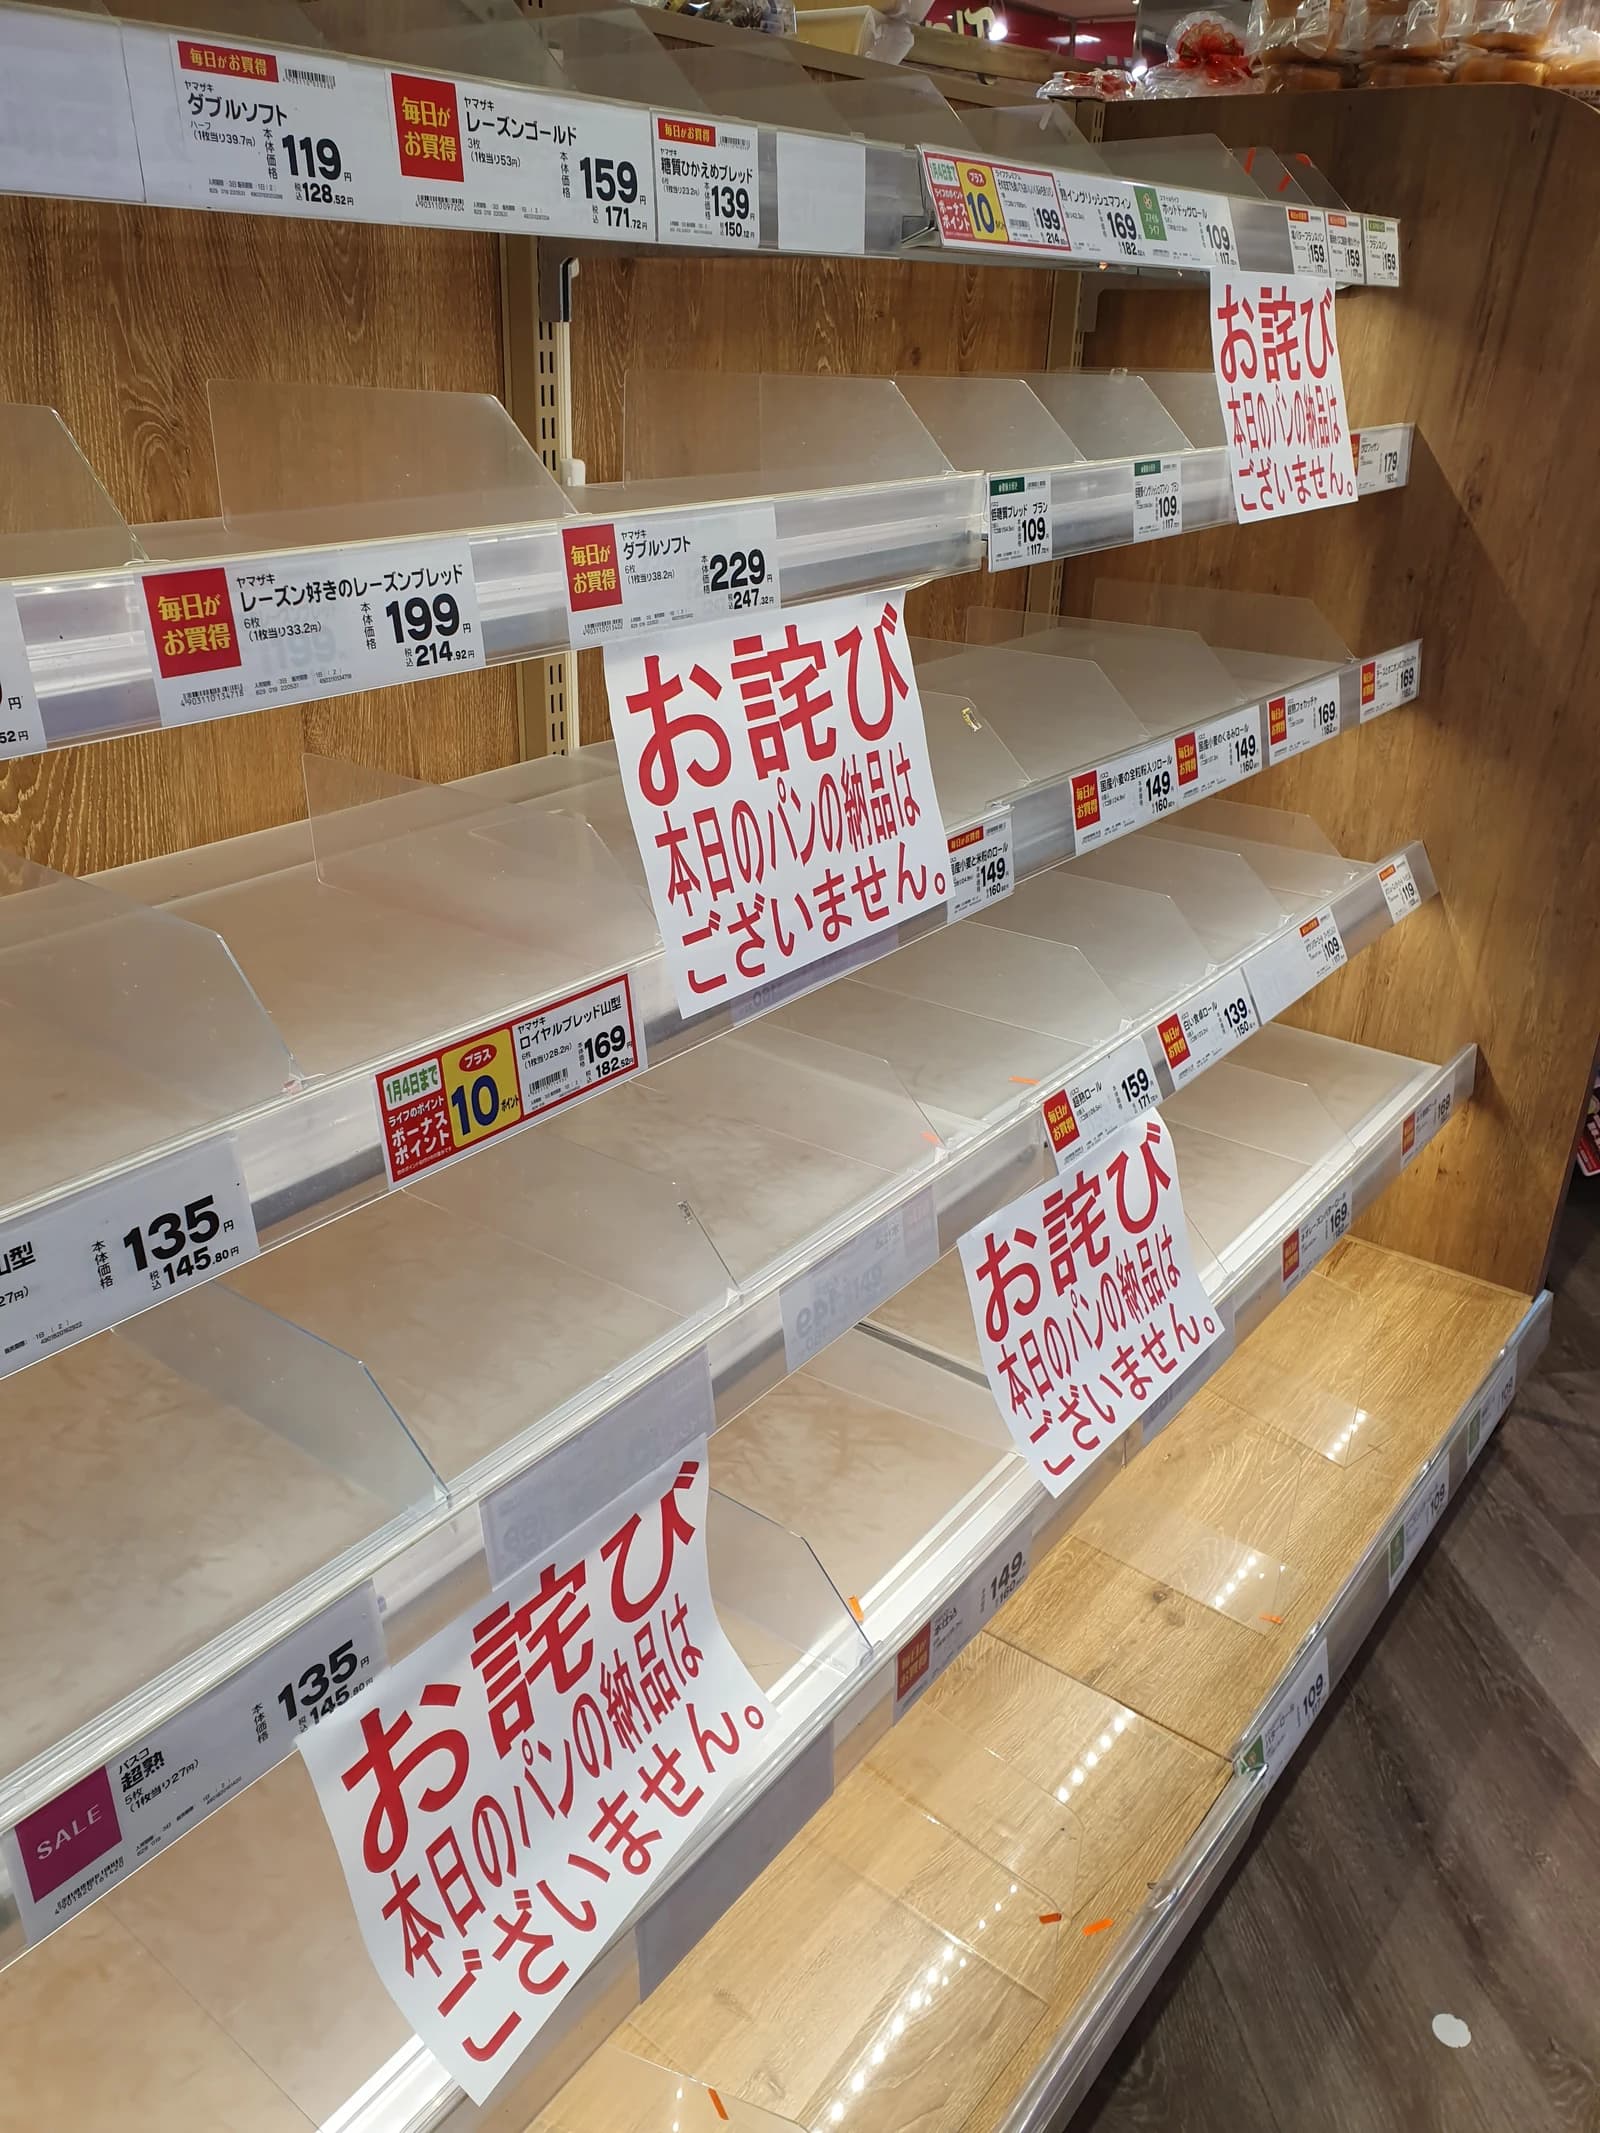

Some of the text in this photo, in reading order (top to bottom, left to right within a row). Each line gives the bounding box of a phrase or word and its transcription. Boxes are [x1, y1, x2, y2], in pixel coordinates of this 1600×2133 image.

[190, 48, 267, 76] 毎日がお買得
[184, 80, 214, 92] ヤマザキ
[187, 93, 287, 127] ダブルソフト
[401, 97, 451, 128] 毎日が
[464, 97, 495, 111] ヤマザキ
[190, 121, 211, 130] ハーフ
[466, 112, 577, 147] レーズンゴールド
[664, 123, 711, 142] 毎日がお買得
[263, 128, 278, 179] 本体価格
[403, 131, 457, 162] お買得
[467, 138, 480, 149] 3枚
[560, 152, 571, 199] 本体価格
[661, 157, 753, 184] 糖質ひかえめブレッド
[967, 191, 995, 234] 10
[1217, 284, 1335, 383] お詫び
[1227, 384, 1341, 458] 本日のパンの納品は
[1238, 452, 1353, 511] ございません。
[621, 529, 647, 540] ヤマザキ
[623, 536, 690, 560] ダブルソフト
[571, 545, 611, 567] 毎日が
[236, 573, 275, 585] ヤマザキ
[240, 564, 463, 612] レーズン好きのレーズンブレッド
[573, 568, 616, 594] お買得
[158, 596, 221, 621] 毎日が
[244, 618, 260, 629] 6枚
[163, 624, 231, 656] お買得
[360, 602, 377, 650] 本体価格
[625, 601, 909, 806] お詫び
[1076, 784, 1095, 800] 毎日が
[655, 742, 921, 917] 本日のパンの納品は
[682, 842, 946, 994] ございません。
[518, 1016, 546, 1033] ヤマザキ
[520, 995, 622, 1050] ロイヤルブレッド山型
[465, 1048, 491, 1068] プラス
[386, 1065, 438, 1103] 1月4日まで
[1072, 1081, 1102, 1108] 超熟ロール
[388, 1096, 444, 1127] ライフのポイント
[450, 1074, 499, 1136] 10
[500, 1096, 519, 1113] ポイント
[1047, 1104, 1068, 1124] 毎日が
[392, 1111, 448, 1147] ボーナス
[1052, 1117, 1075, 1141] お買得
[394, 1132, 449, 1165] ポイント
[975, 1122, 1171, 1343] お詫び
[91, 1240, 114, 1290] 本体価格
[150, 1270, 162, 1290] 税込
[997, 1224, 1180, 1420] 本日のパンの納品は
[1029, 1303, 1215, 1476] ございません。
[340, 1461, 700, 1874] お詫び
[251, 1703, 269, 1744] 本体価格
[118, 1748, 150, 1775] パスコ
[120, 1751, 165, 1793] 超熟
[125, 1787, 143, 1806] 5枚
[382, 1593, 704, 1979] 本日のパンの納品は
[36, 1804, 103, 1860] SALE
[436, 1703, 764, 2062] ございません。
